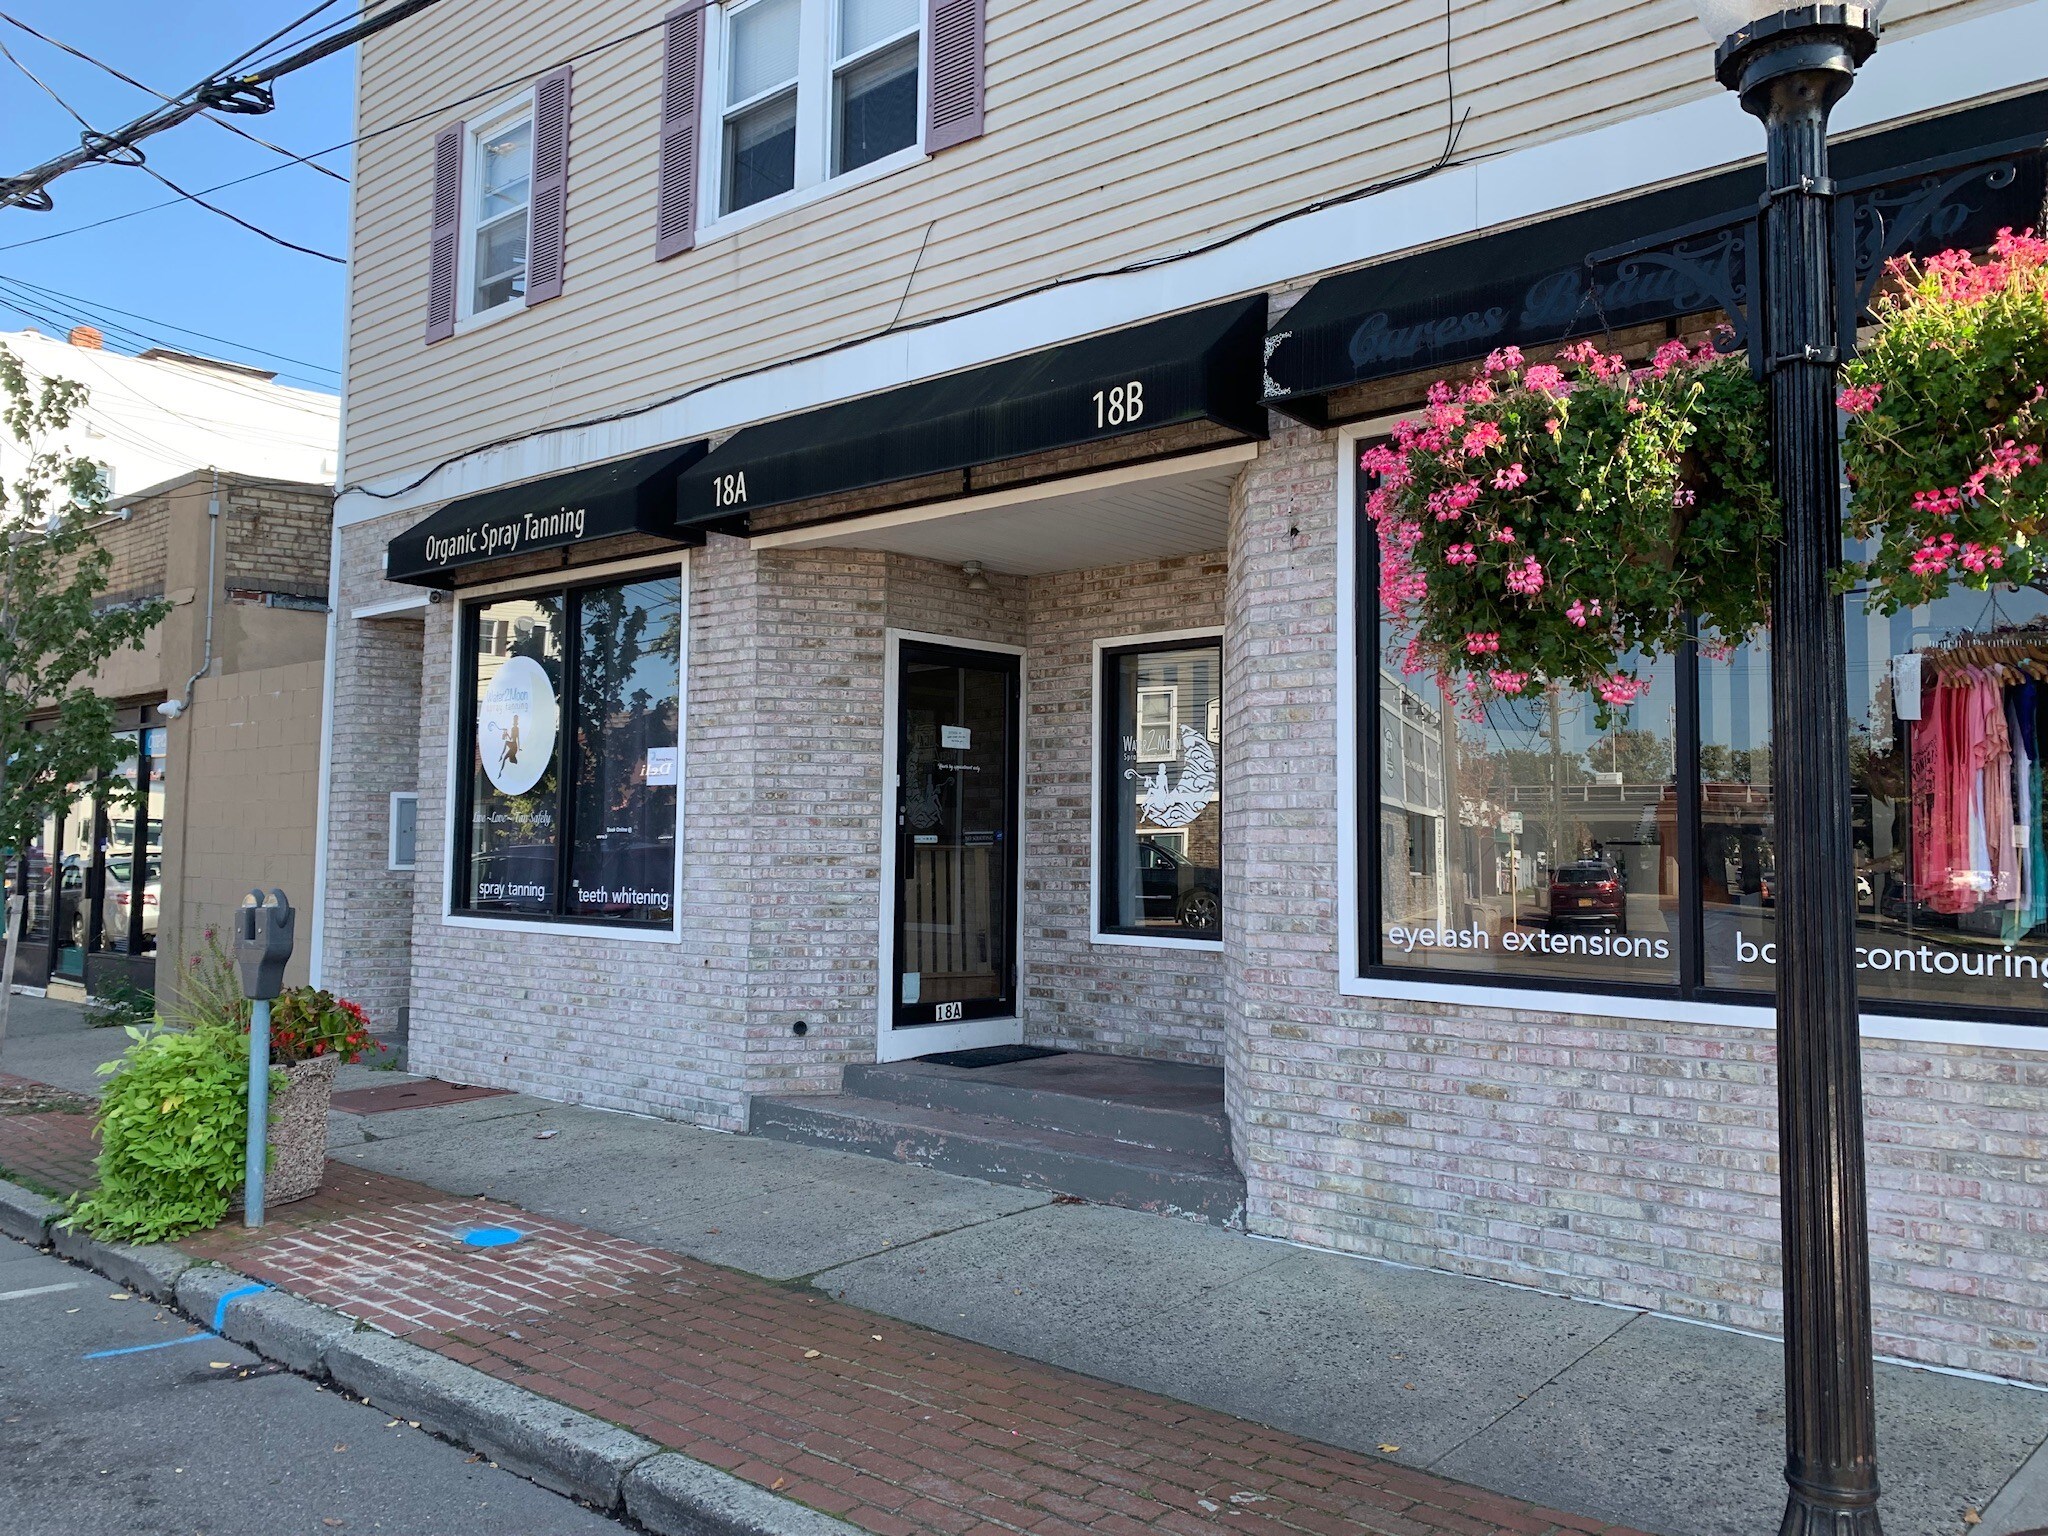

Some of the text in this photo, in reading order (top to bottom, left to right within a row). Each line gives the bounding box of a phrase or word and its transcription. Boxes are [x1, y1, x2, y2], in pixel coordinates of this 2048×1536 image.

[1091, 380, 1145, 429] 18B
[712, 470, 748, 508] 18A
[425, 506, 586, 566] Organic Spray Tanning
[479, 880, 546, 902] spray tanning
[578, 885, 669, 911] teeth whitening
[1388, 920, 1670, 960] eyelash extensions
[937, 1002, 961, 1020] 18A
